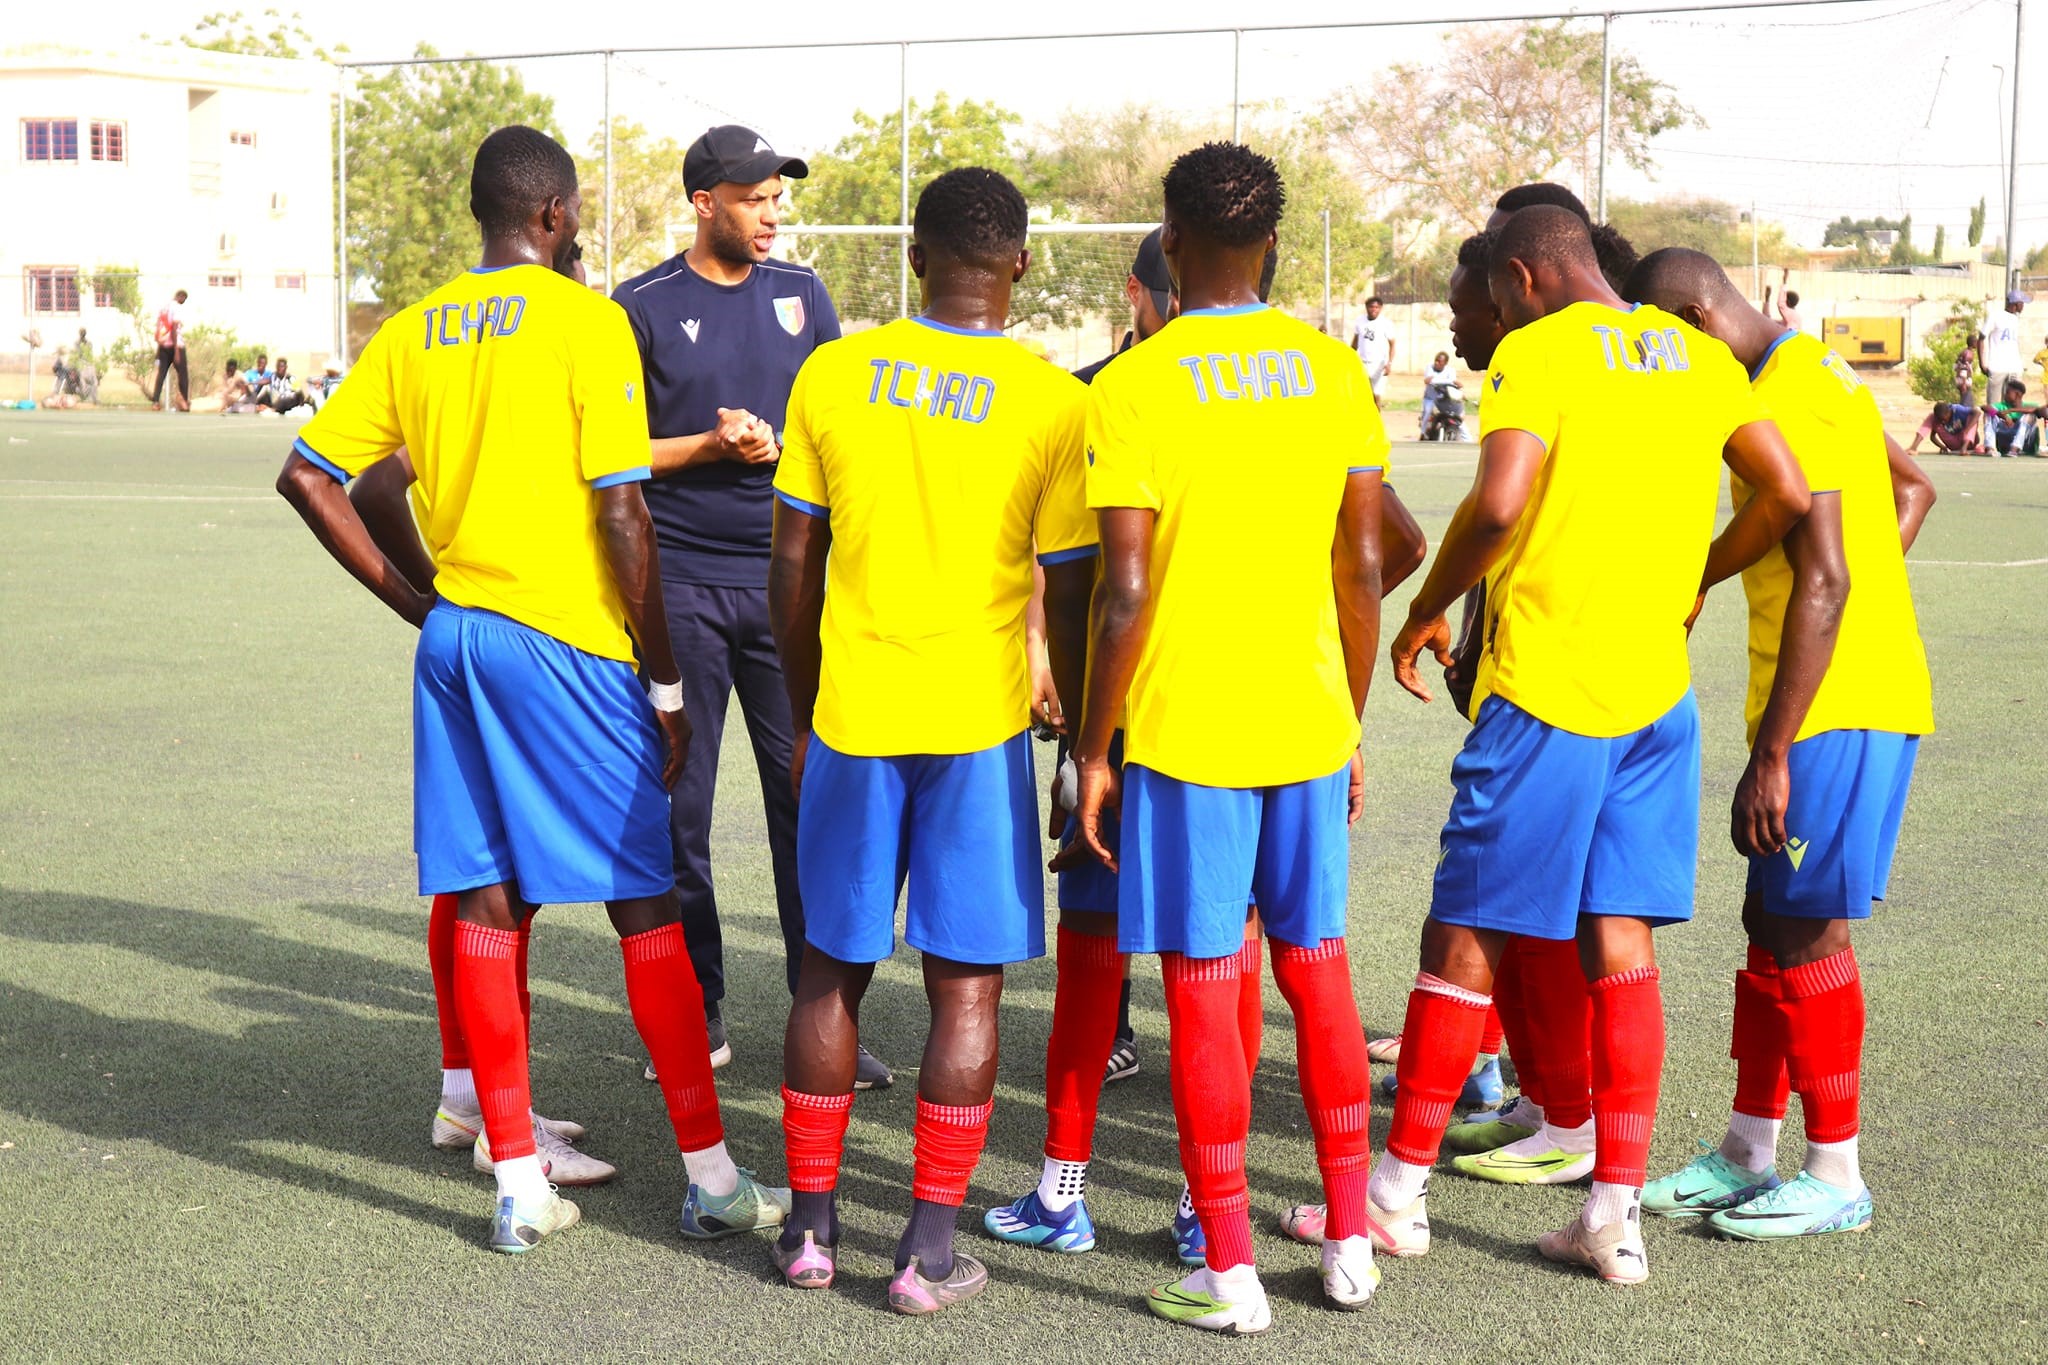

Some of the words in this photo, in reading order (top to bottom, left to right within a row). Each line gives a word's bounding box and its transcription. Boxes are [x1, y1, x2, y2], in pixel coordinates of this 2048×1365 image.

[424, 295, 526, 350] TCHAD
[869, 358, 996, 424] TCHAD
[1179, 350, 1315, 402] TCHAD
